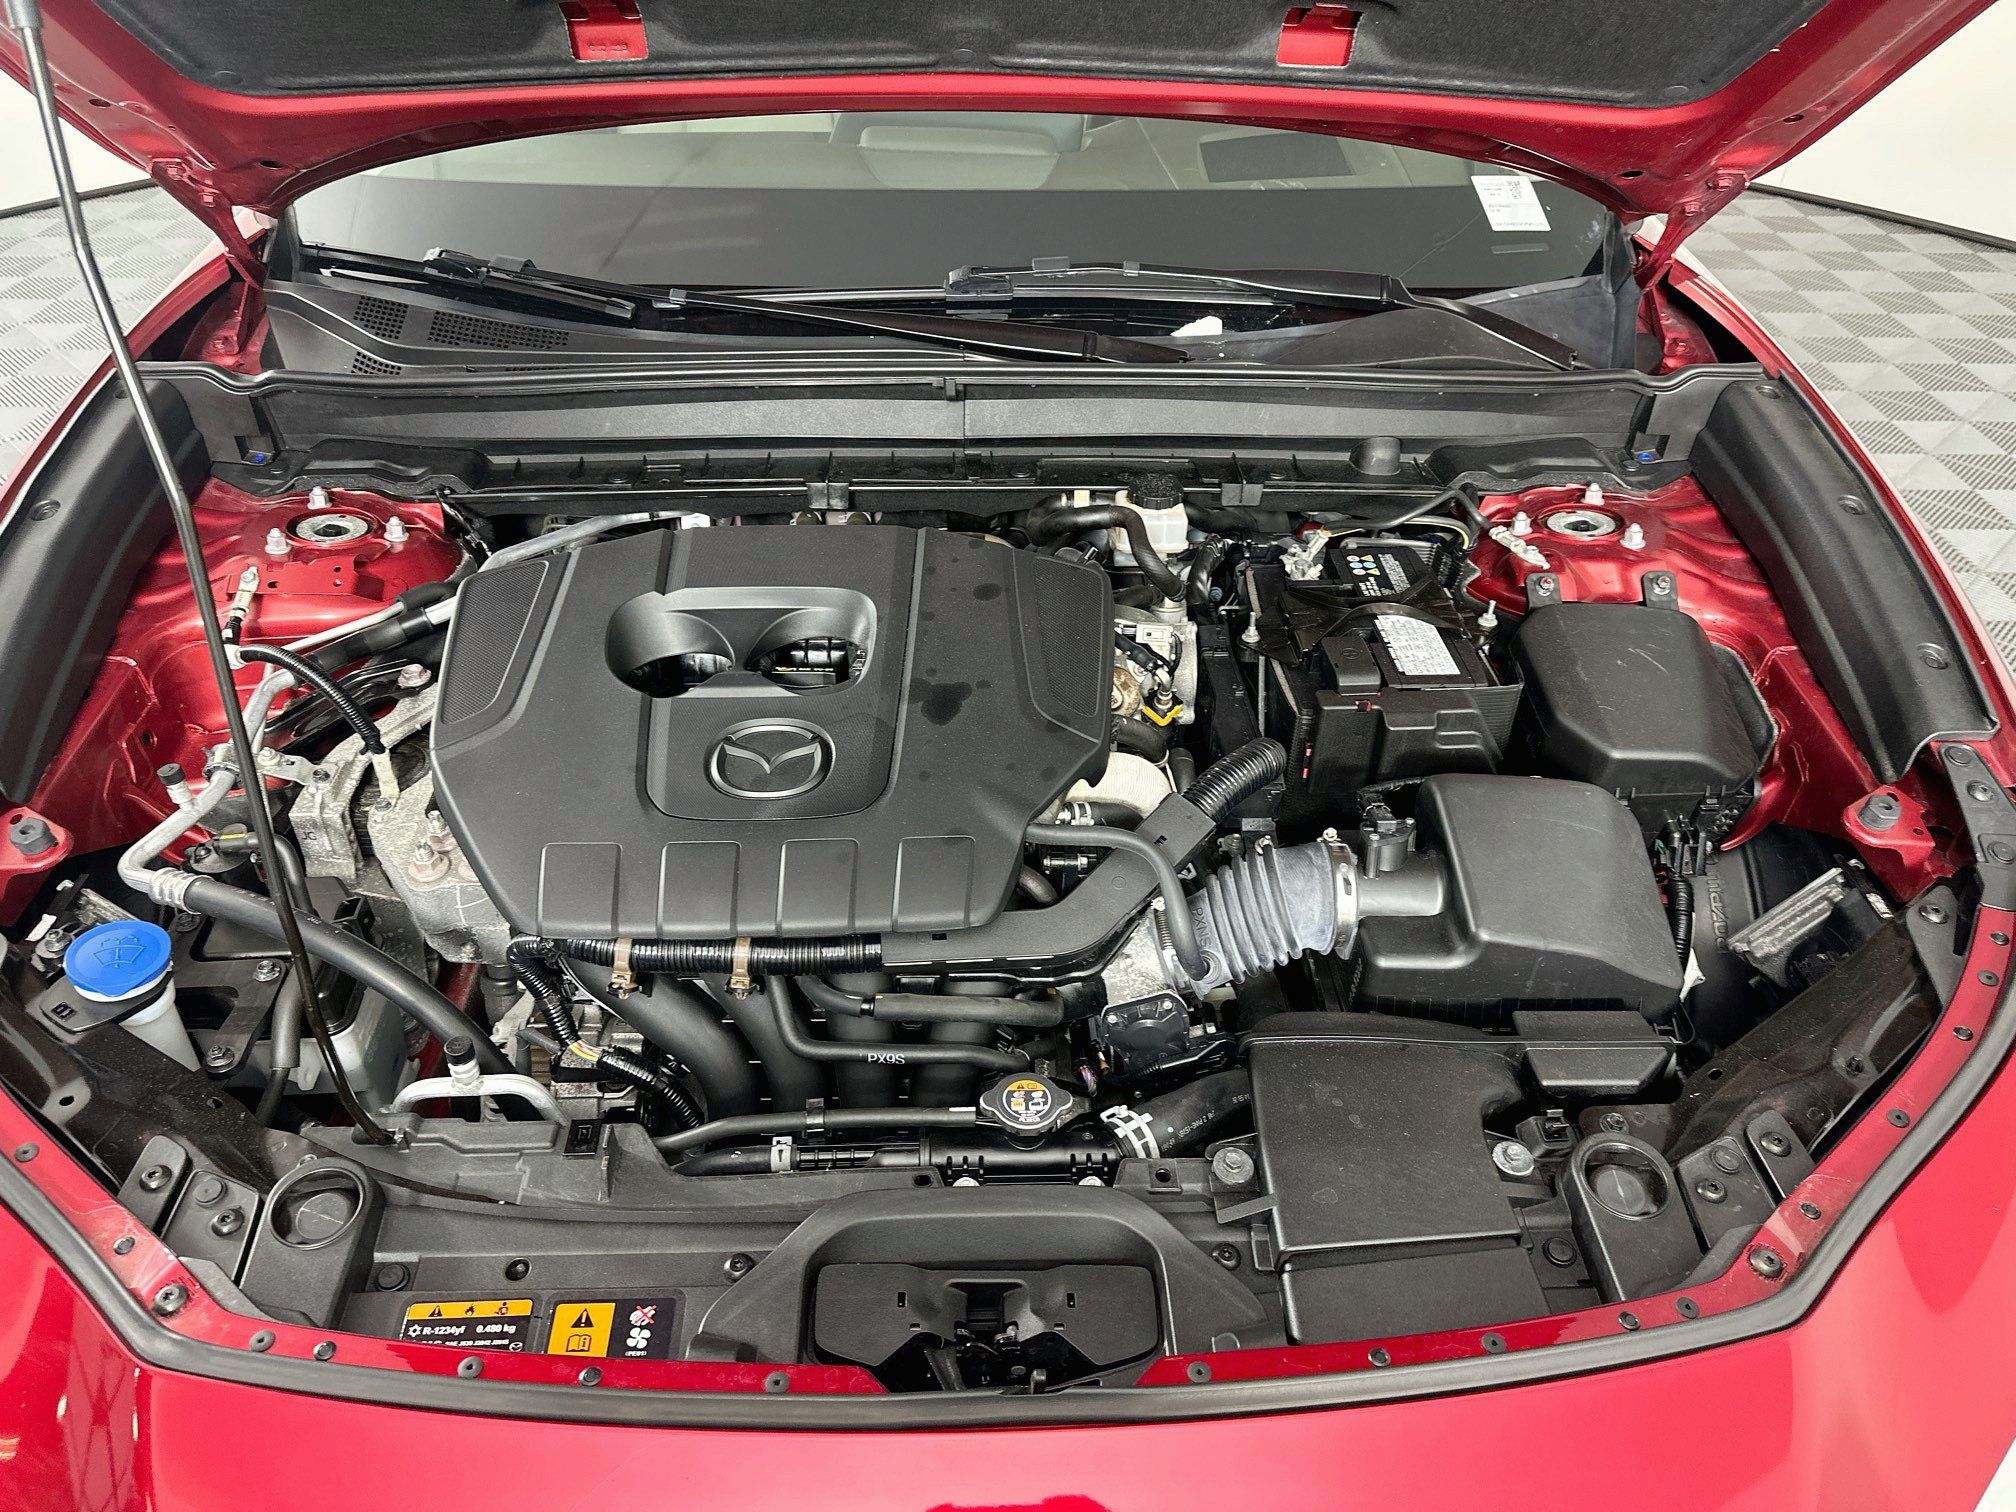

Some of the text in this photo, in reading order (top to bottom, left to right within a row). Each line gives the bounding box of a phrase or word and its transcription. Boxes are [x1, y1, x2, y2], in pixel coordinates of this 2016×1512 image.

[867, 1053, 905, 1064] PX9S
[422, 1325, 467, 1336] R-1234yf
[503, 1323, 517, 1334] kg
